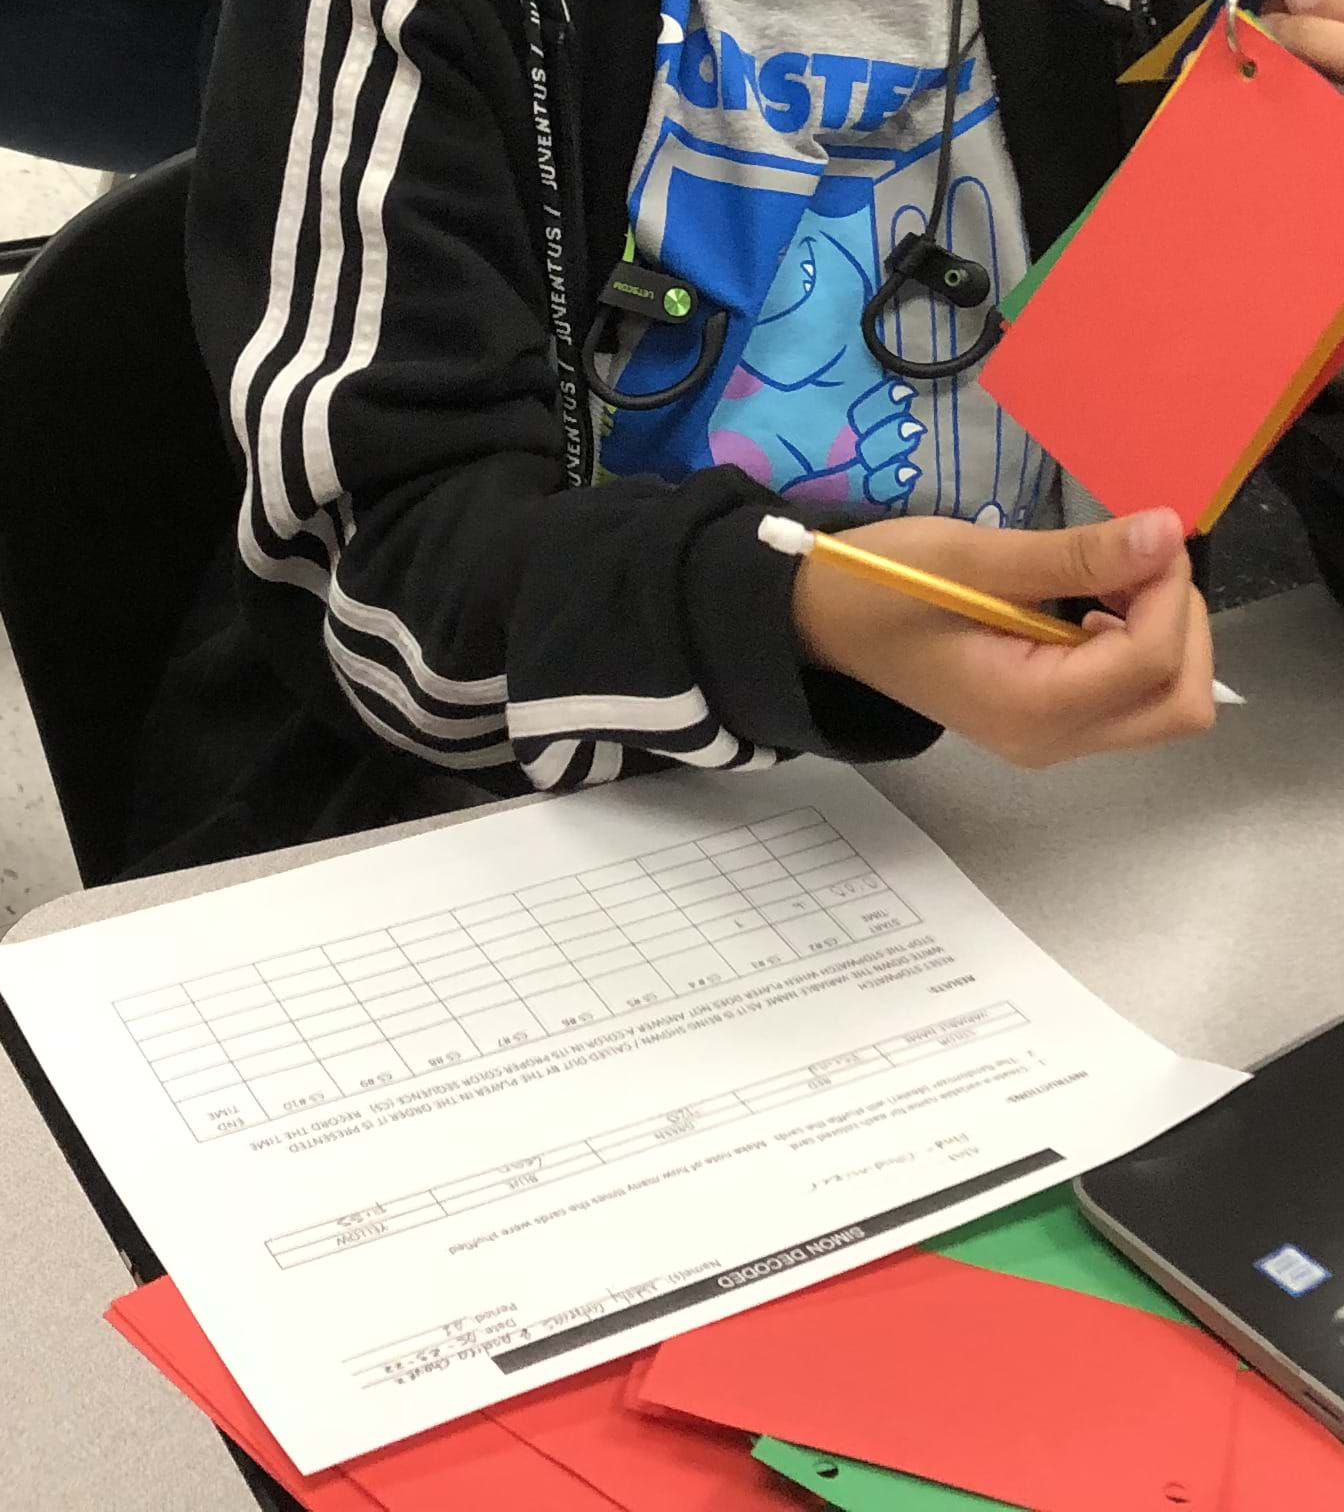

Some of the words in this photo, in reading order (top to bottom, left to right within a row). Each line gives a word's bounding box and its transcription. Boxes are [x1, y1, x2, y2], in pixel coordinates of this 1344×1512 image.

[531, 66, 558, 191] JUVENTUS
[545, 226, 573, 346] JUVENTUS
[560, 380, 583, 488] UVENTUS
[250, 1136, 282, 1151] TIME
[717, 1249, 807, 1289] DECODED
[806, 1226, 866, 1256] SIMON
